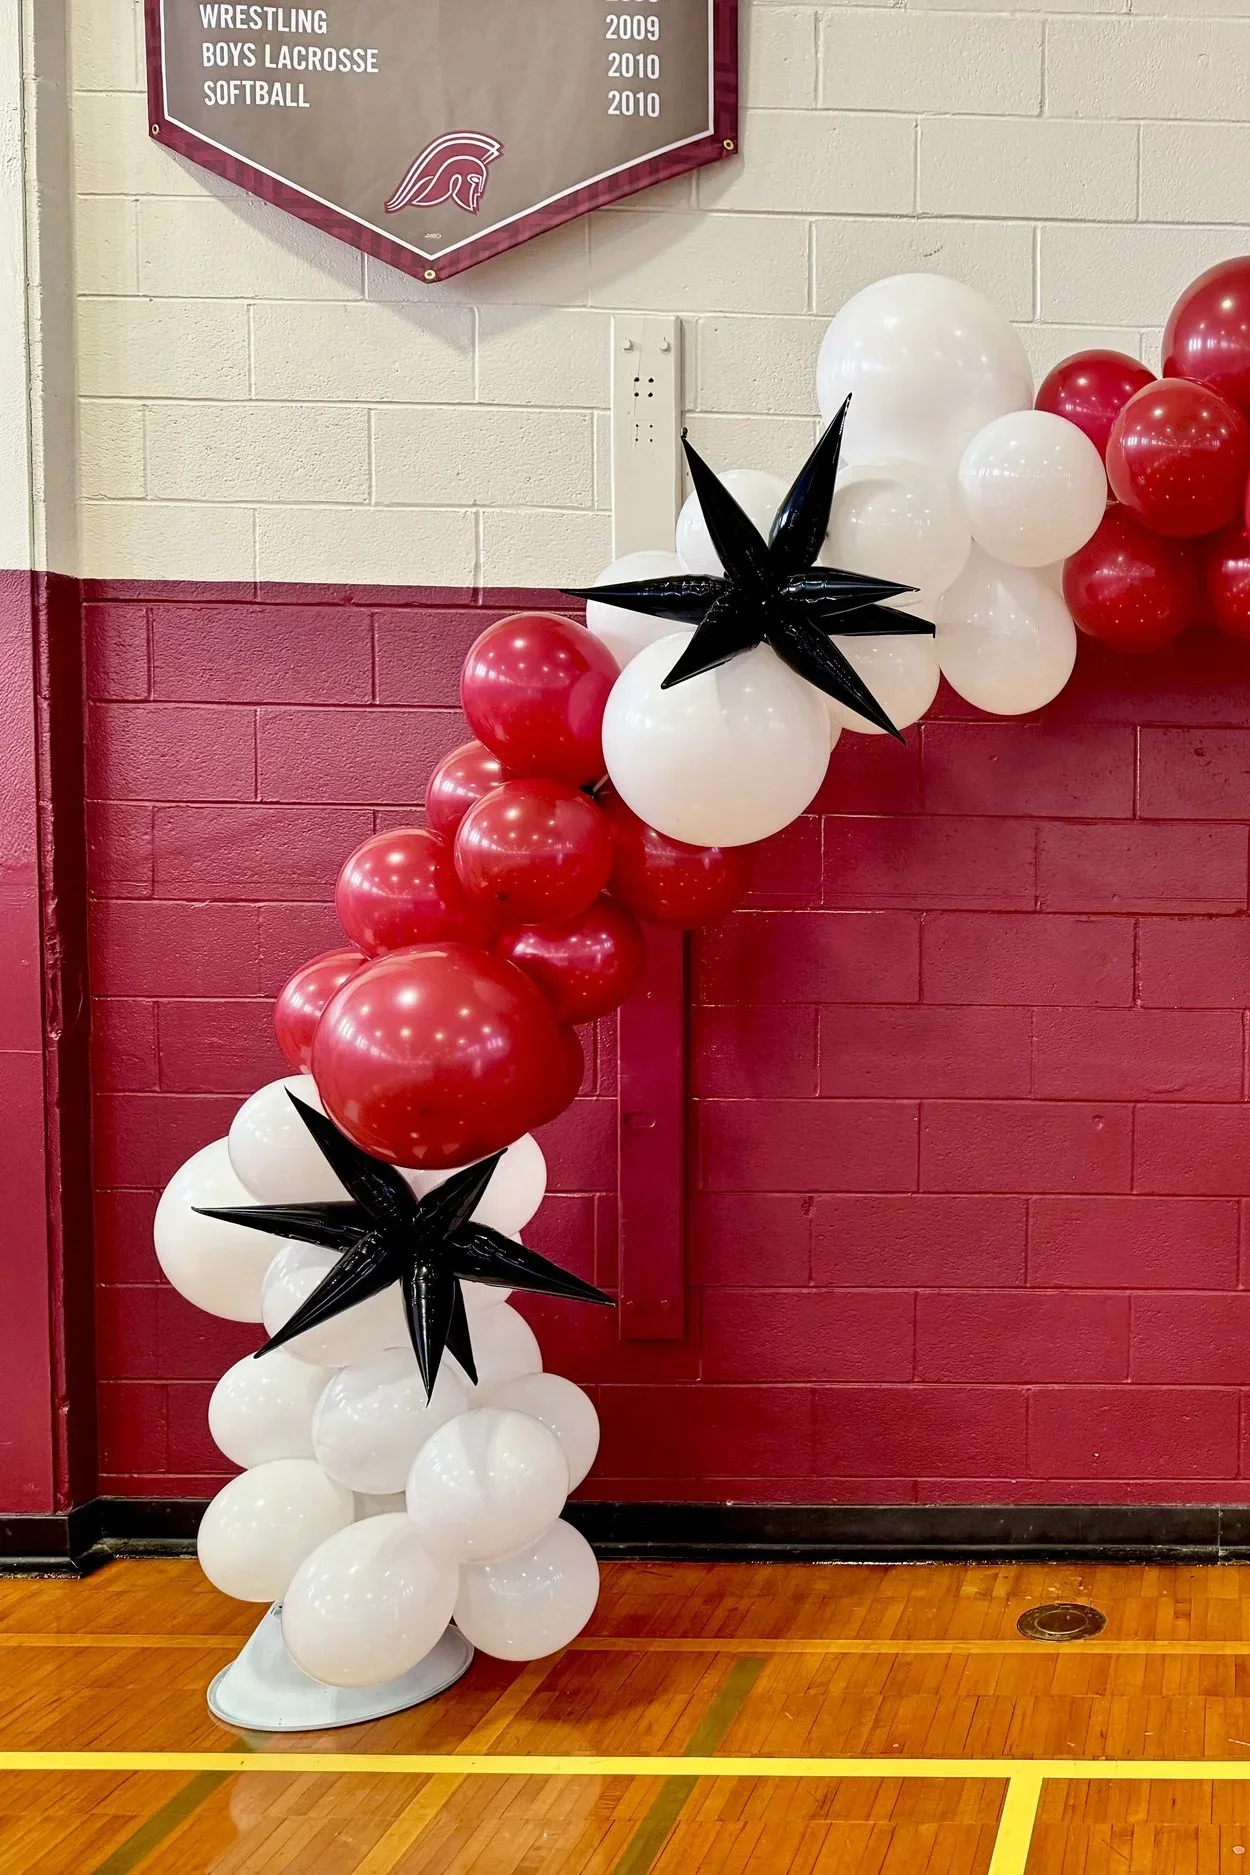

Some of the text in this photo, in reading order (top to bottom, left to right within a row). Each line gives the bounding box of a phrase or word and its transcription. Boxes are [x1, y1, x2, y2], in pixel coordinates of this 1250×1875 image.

[199, 3, 328, 35] WRESTLING
[605, 14, 660, 42] 2009
[202, 41, 379, 74] BOYS LACROSSE
[607, 52, 660, 80] 2010
[203, 79, 310, 108] SOFTBALL
[607, 90, 660, 118] 2010
